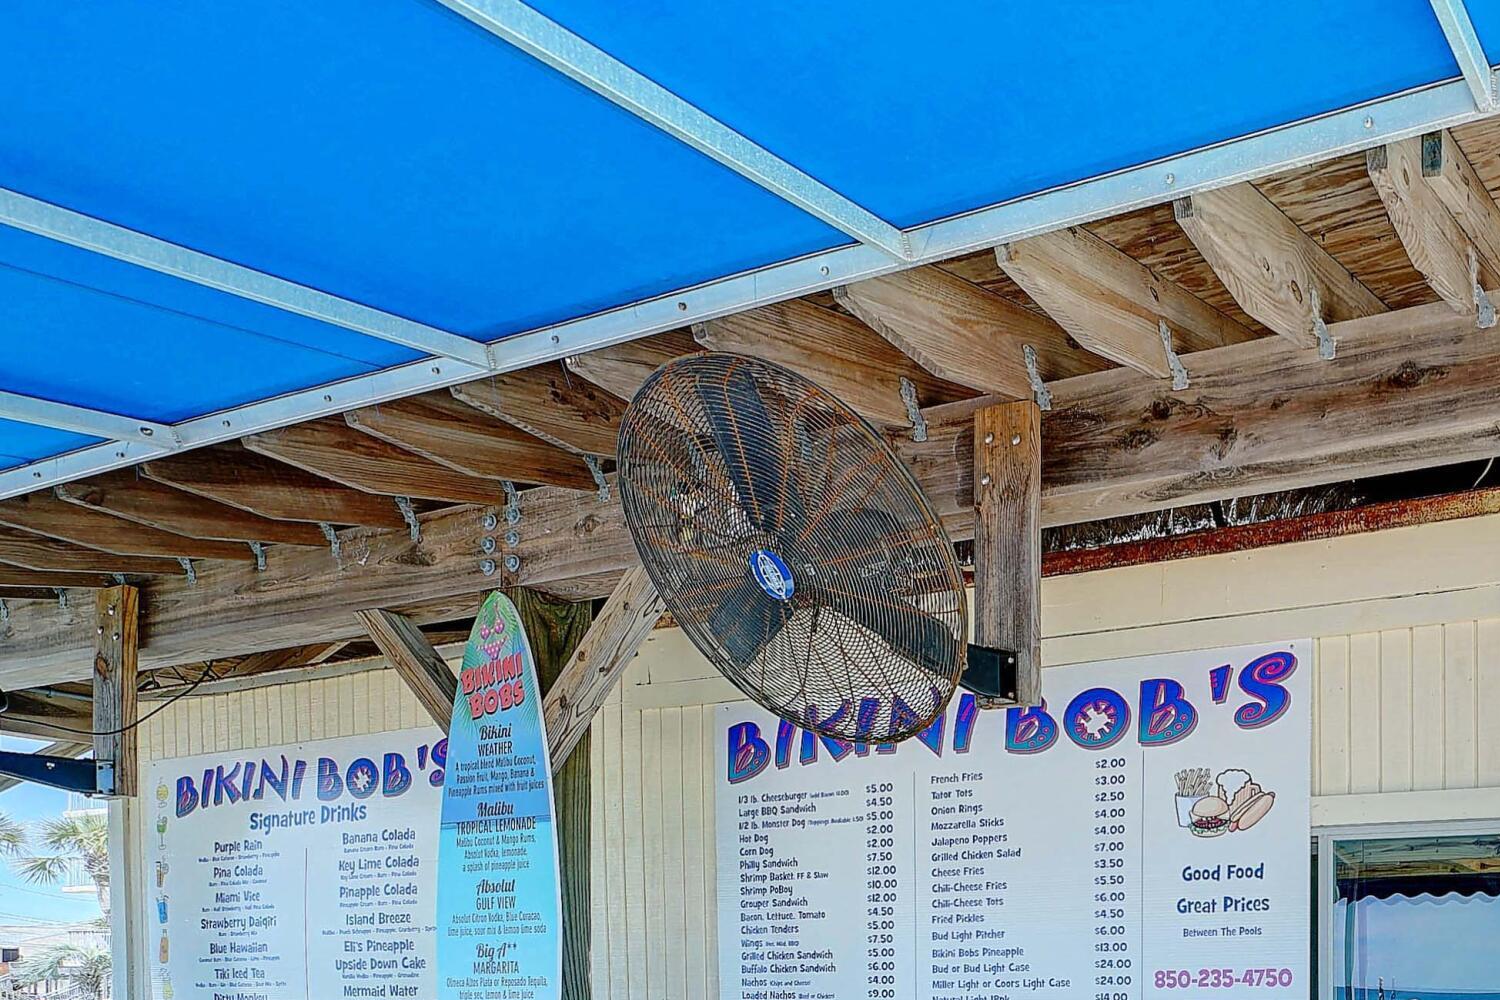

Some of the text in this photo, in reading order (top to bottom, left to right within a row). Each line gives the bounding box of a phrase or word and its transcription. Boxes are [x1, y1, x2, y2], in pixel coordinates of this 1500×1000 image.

[461, 652, 523, 695] BIKINI
[469, 680, 525, 720] BOBS
[728, 651, 1298, 784] BIKINI BOB'S
[481, 723, 511, 740] Bikini
[478, 741, 512, 756] WEATHER
[176, 738, 448, 819] BIKINI BOB'S
[931, 758, 1125, 784] French Fries $2.00
[931, 775, 1125, 800] Tator Tots $3.00
[477, 802, 514, 817] Malibu
[738, 797, 892, 819] Large BBQ Sandwich $4.50
[931, 792, 1125, 815] Onion Rings $2.50
[250, 803, 366, 835] Signature Drinks
[456, 816, 536, 835] TROPICAL LEMONADE
[931, 808, 1125, 830] Mozzarella Sticks $4.00
[342, 828, 415, 844] Banana Colada
[739, 825, 893, 845] Hot Dog $2.00
[973, 834, 1007, 845] Poppers
[1094, 825, 1125, 835] $4.00
[215, 840, 262, 854] Purple Rain
[740, 839, 893, 858] Corn Dog $2.00
[932, 842, 1124, 861] Grilled Chicken Salad $7.00
[235, 865, 263, 877] Colada
[339, 855, 419, 875] Key Lime Colada
[931, 859, 1124, 877] Cheese Fries $3.50
[1182, 862, 1264, 881] Good Food
[384, 883, 417, 895] Colada
[476, 879, 515, 896] Absolut
[740, 880, 897, 896] Shrimp PoBoy $10.00
[986, 882, 1007, 890] Fries
[1094, 875, 1124, 885] $5.50
[216, 891, 260, 903] Miami Vice
[476, 896, 516, 910] GULF VIEW
[1095, 892, 1125, 902] $6.00
[1177, 896, 1269, 913] Great Prices
[346, 913, 411, 925] Island Breeze
[956, 914, 984, 922] Pickles
[1095, 909, 1124, 918] $4.50
[201, 918, 246, 930] Strawberry
[1183, 926, 1262, 937] Between The Pools
[932, 926, 1125, 942] Bud Light Pitcher $6.00
[210, 942, 267, 954] Blue Hawaiian
[367, 939, 414, 954] Pineapple
[476, 943, 496, 962] Big
[932, 943, 1127, 958] Bikini Bobs Pineapple $13.00
[336, 957, 426, 973] Upside Down Cake
[474, 961, 519, 974] MARGARITA
[932, 965, 948, 973] Bud
[964, 964, 980, 973] Bud
[984, 963, 1005, 975] Light
[1009, 963, 1030, 971] Case
[1095, 959, 1131, 969] $24.00
[215, 968, 265, 979] Tiki Iced Tea
[1154, 968, 1292, 988] 850-235-4750
[344, 985, 418, 996] Mermaid Water
[932, 981, 954, 989] Miller
[958, 980, 979, 991] Light
[995, 979, 1019, 988] Coors
[1023, 978, 1044, 990] Light
[1049, 979, 1070, 987] Case
[1095, 976, 1131, 985] $24.00
